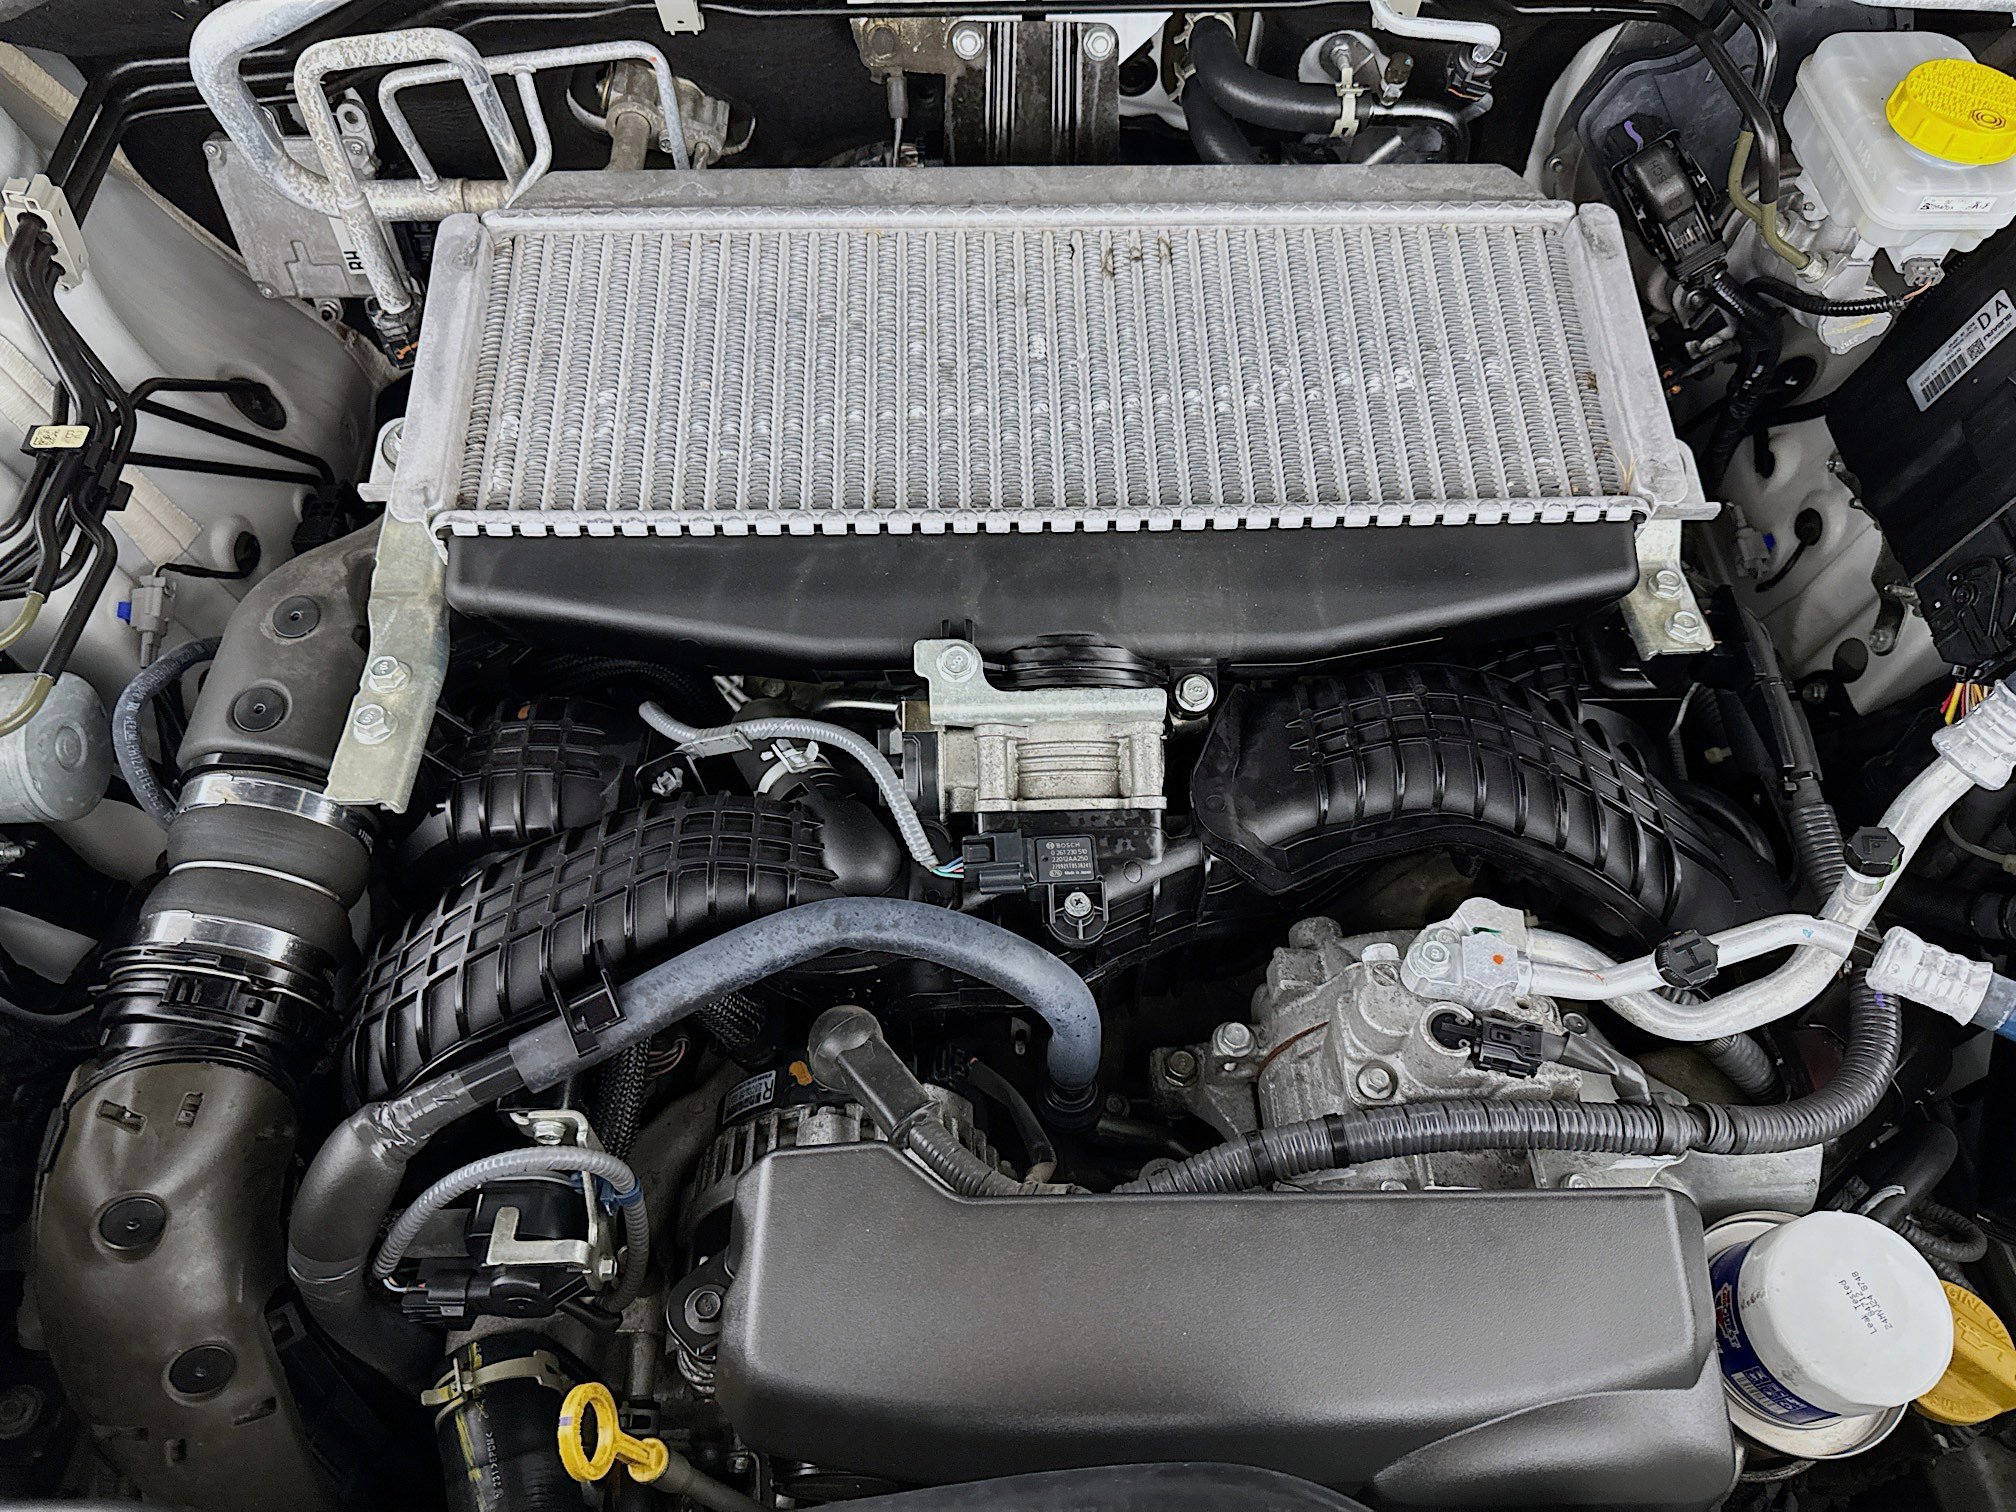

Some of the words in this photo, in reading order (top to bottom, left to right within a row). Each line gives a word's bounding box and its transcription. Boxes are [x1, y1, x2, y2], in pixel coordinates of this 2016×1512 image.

[343, 251, 364, 270] RH
[1977, 312, 1991, 331] D
[1995, 299, 2009, 317] A
[1983, 313, 2012, 341] SUBARU
[1051, 855, 1089, 863] 22012AA250
[1674, 939, 1712, 975] H
[763, 1079, 774, 1100] R
[1838, 1279, 1861, 1310] Tested
[1945, 1284, 1986, 1314] GINE
[1861, 1315, 1878, 1335] Leak
